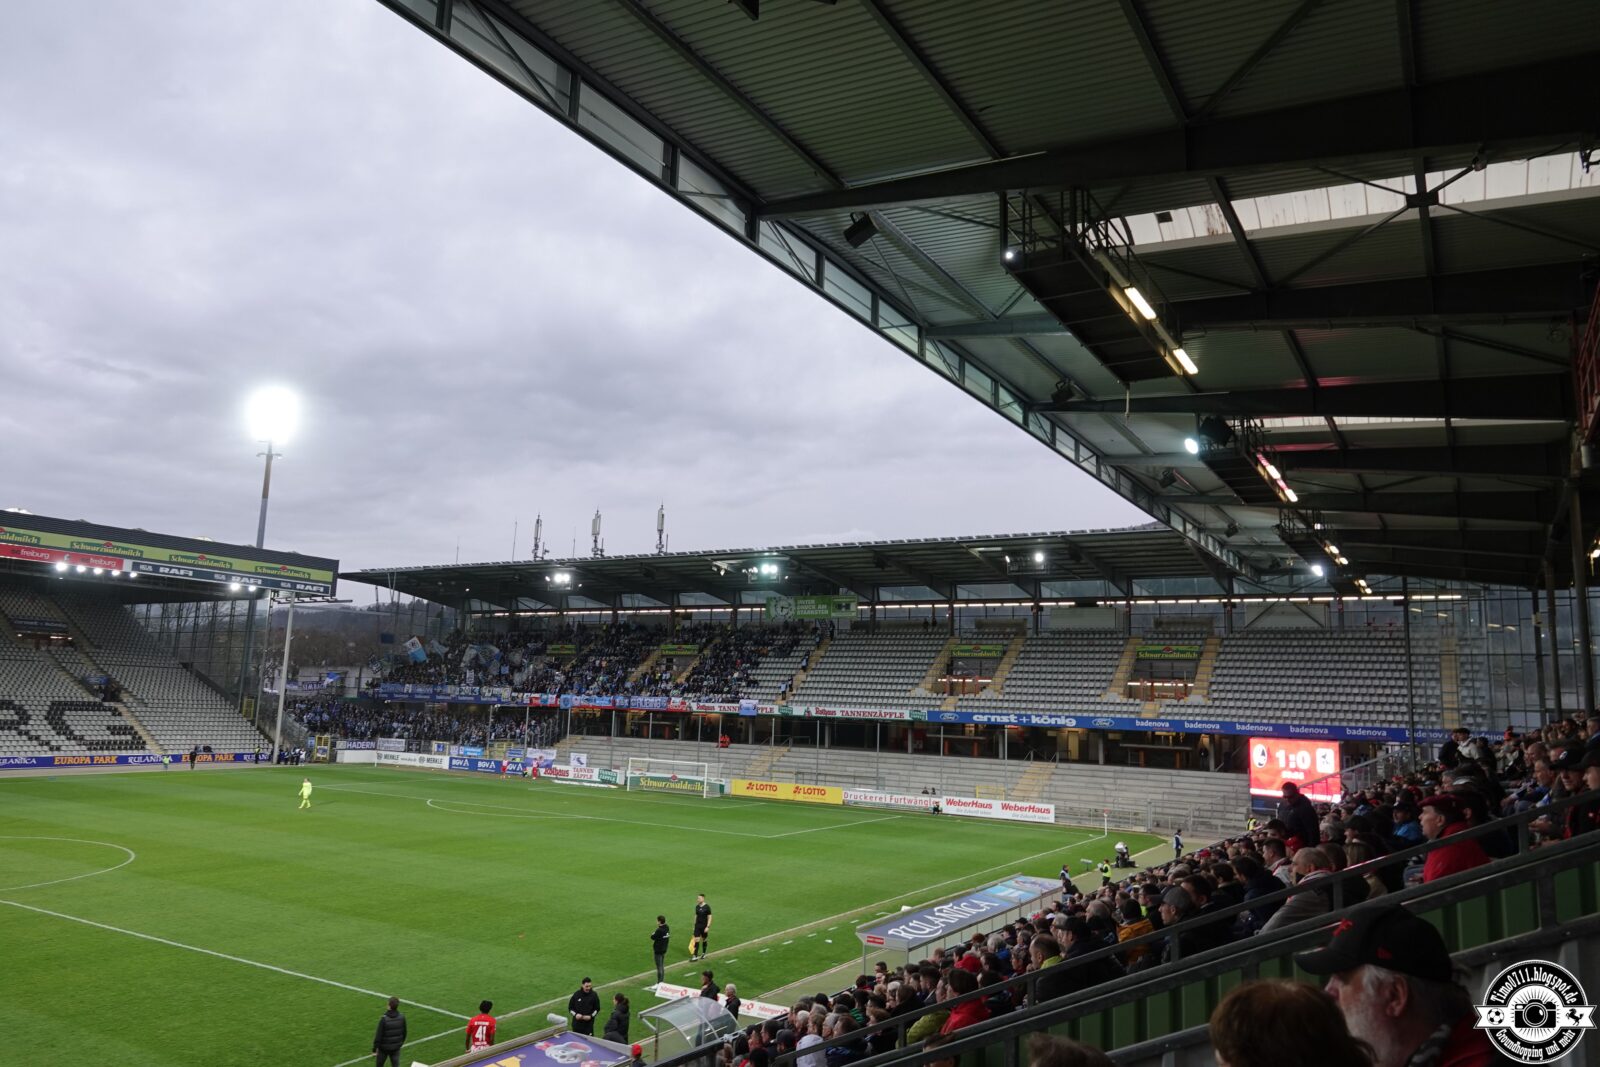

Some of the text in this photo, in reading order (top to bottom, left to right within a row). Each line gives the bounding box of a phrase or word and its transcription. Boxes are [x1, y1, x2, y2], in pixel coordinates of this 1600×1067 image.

[159, 566, 193, 577] RAFI
[231, 575, 262, 585] RAFI
[296, 583, 324, 592] RAFI
[840, 709, 905, 719] TANNENZÄPFLE
[972, 713, 1018, 723] ernst
[1031, 713, 1076, 727] könig
[1135, 719, 1169, 728] badenova
[1184, 721, 1220, 730] badenova
[1236, 723, 1273, 732] badenova
[1289, 725, 1328, 735] badenova
[1346, 728, 1387, 737] badenova
[54, 755, 118, 765] EUROPA PARK
[755, 783, 777, 792] LOTTO
[802, 787, 826, 796] LOTTO
[843, 791, 887, 802] Druckerei
[946, 798, 993, 810] WeberHaus
[1001, 802, 1051, 815] WeberHaus
[888, 897, 1000, 939] RULANTICA
[475, 1025, 487, 1042] 41
